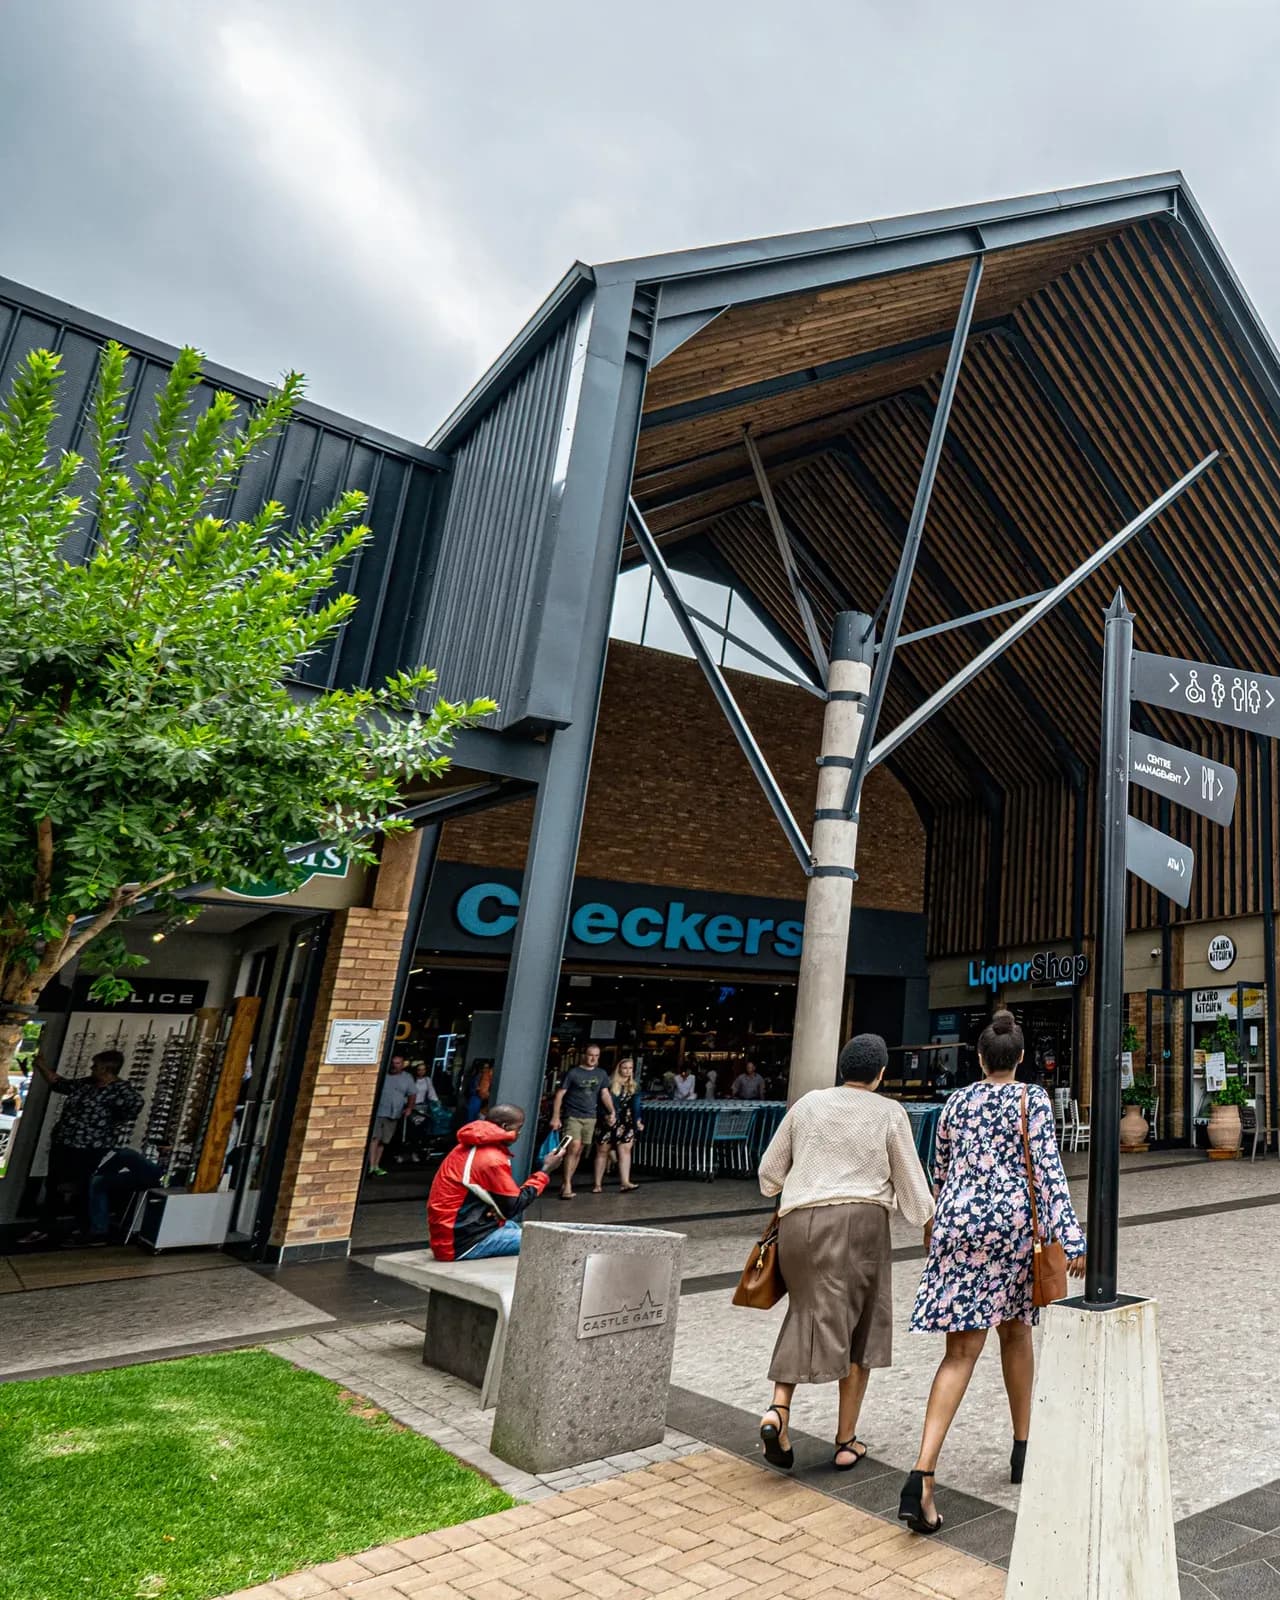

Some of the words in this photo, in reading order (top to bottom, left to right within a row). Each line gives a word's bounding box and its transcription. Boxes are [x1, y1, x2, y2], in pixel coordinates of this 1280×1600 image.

[1147, 753, 1172, 770] CENTRE
[1134, 761, 1182, 784] MANAGEMENT
[1167, 857, 1179, 872] ATM
[456, 882, 804, 957] Ceckers
[86, 991, 194, 1004] PLICE
[583, 1315, 629, 1332] CASTLE
[632, 1309, 664, 1323] GATE
